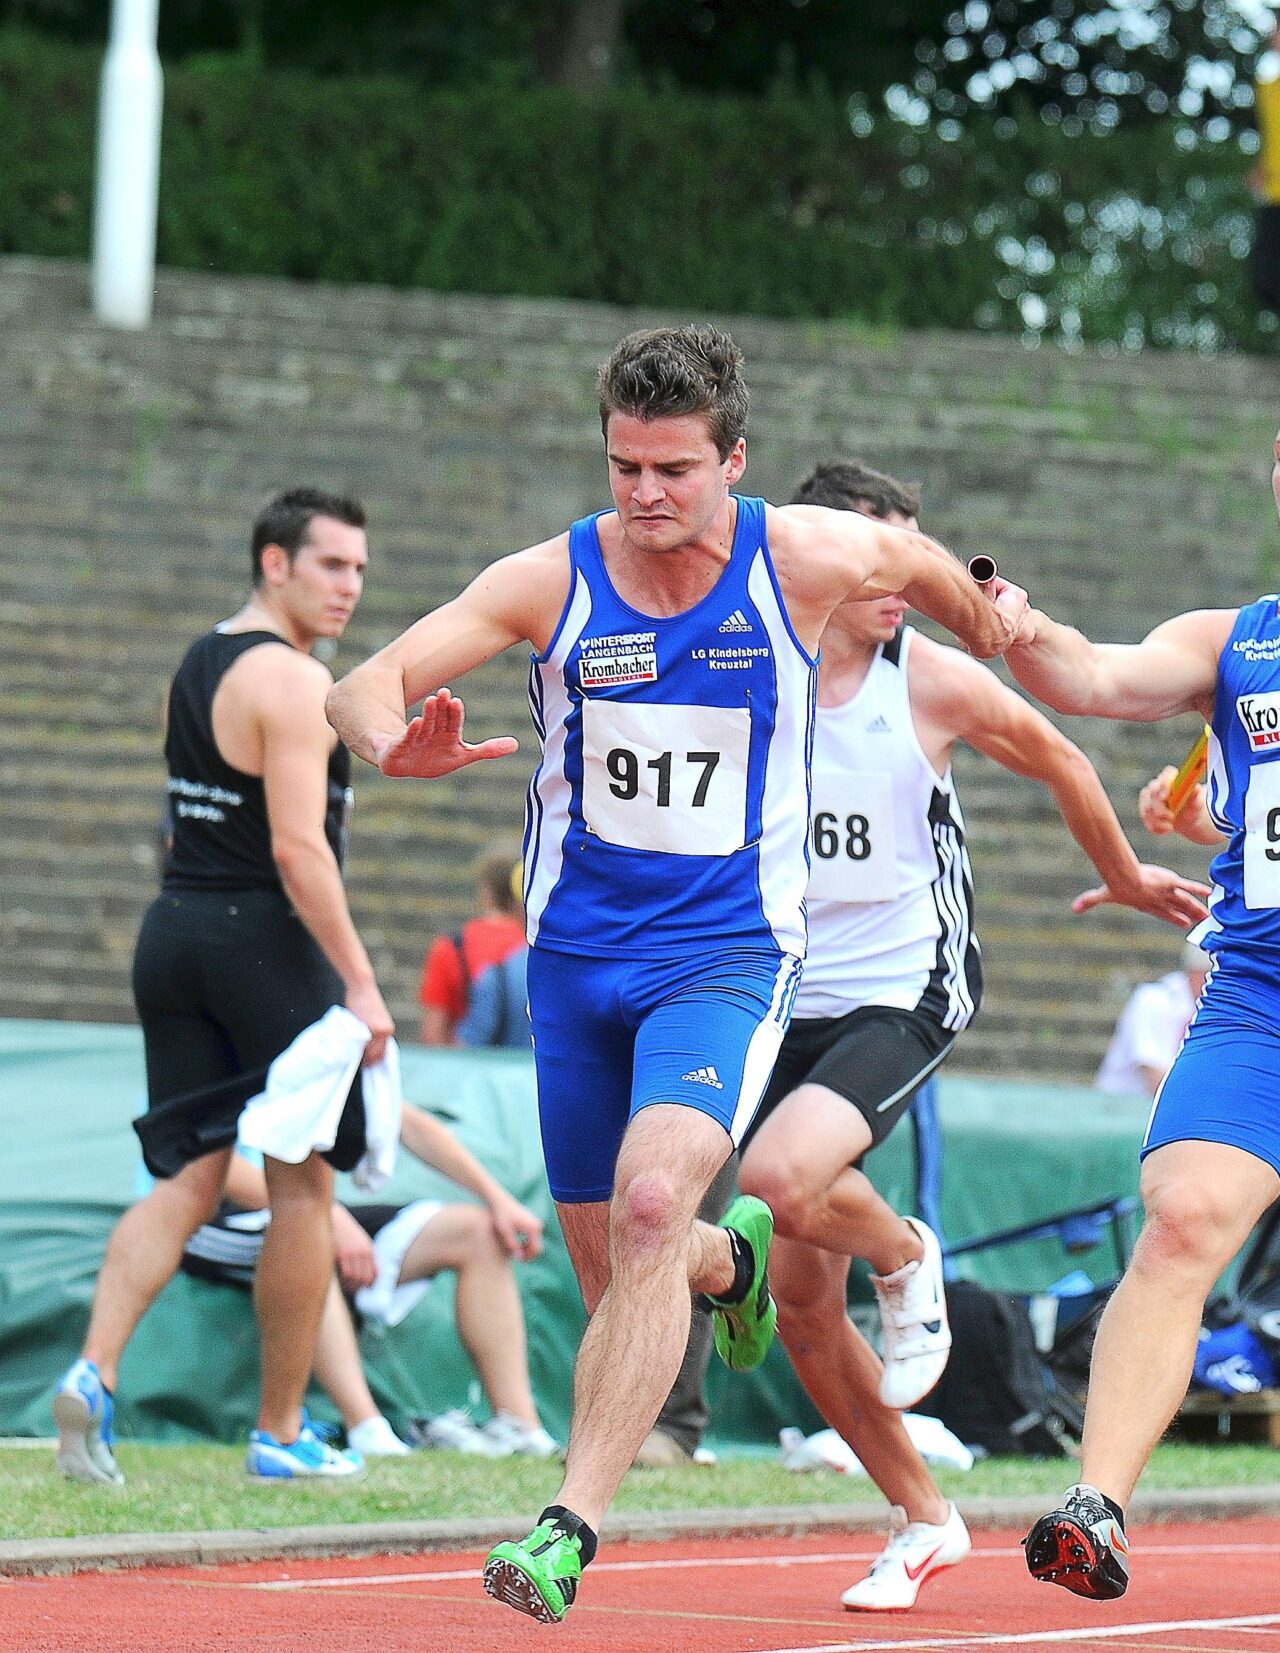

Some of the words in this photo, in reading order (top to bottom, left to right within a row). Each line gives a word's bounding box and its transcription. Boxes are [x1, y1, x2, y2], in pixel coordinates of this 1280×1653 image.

[719, 624, 753, 634] adidas
[590, 632, 657, 648] INTERSPORT
[582, 644, 654, 659] LANGENBACH
[691, 649, 706, 660] LG
[708, 646, 769, 659] Kindelsberg
[581, 657, 655, 679] Krombacher
[709, 659, 753, 670] Kreuztal
[606, 748, 720, 807] 917
[813, 812, 872, 860] 68
[681, 1074, 724, 1090] adidas
